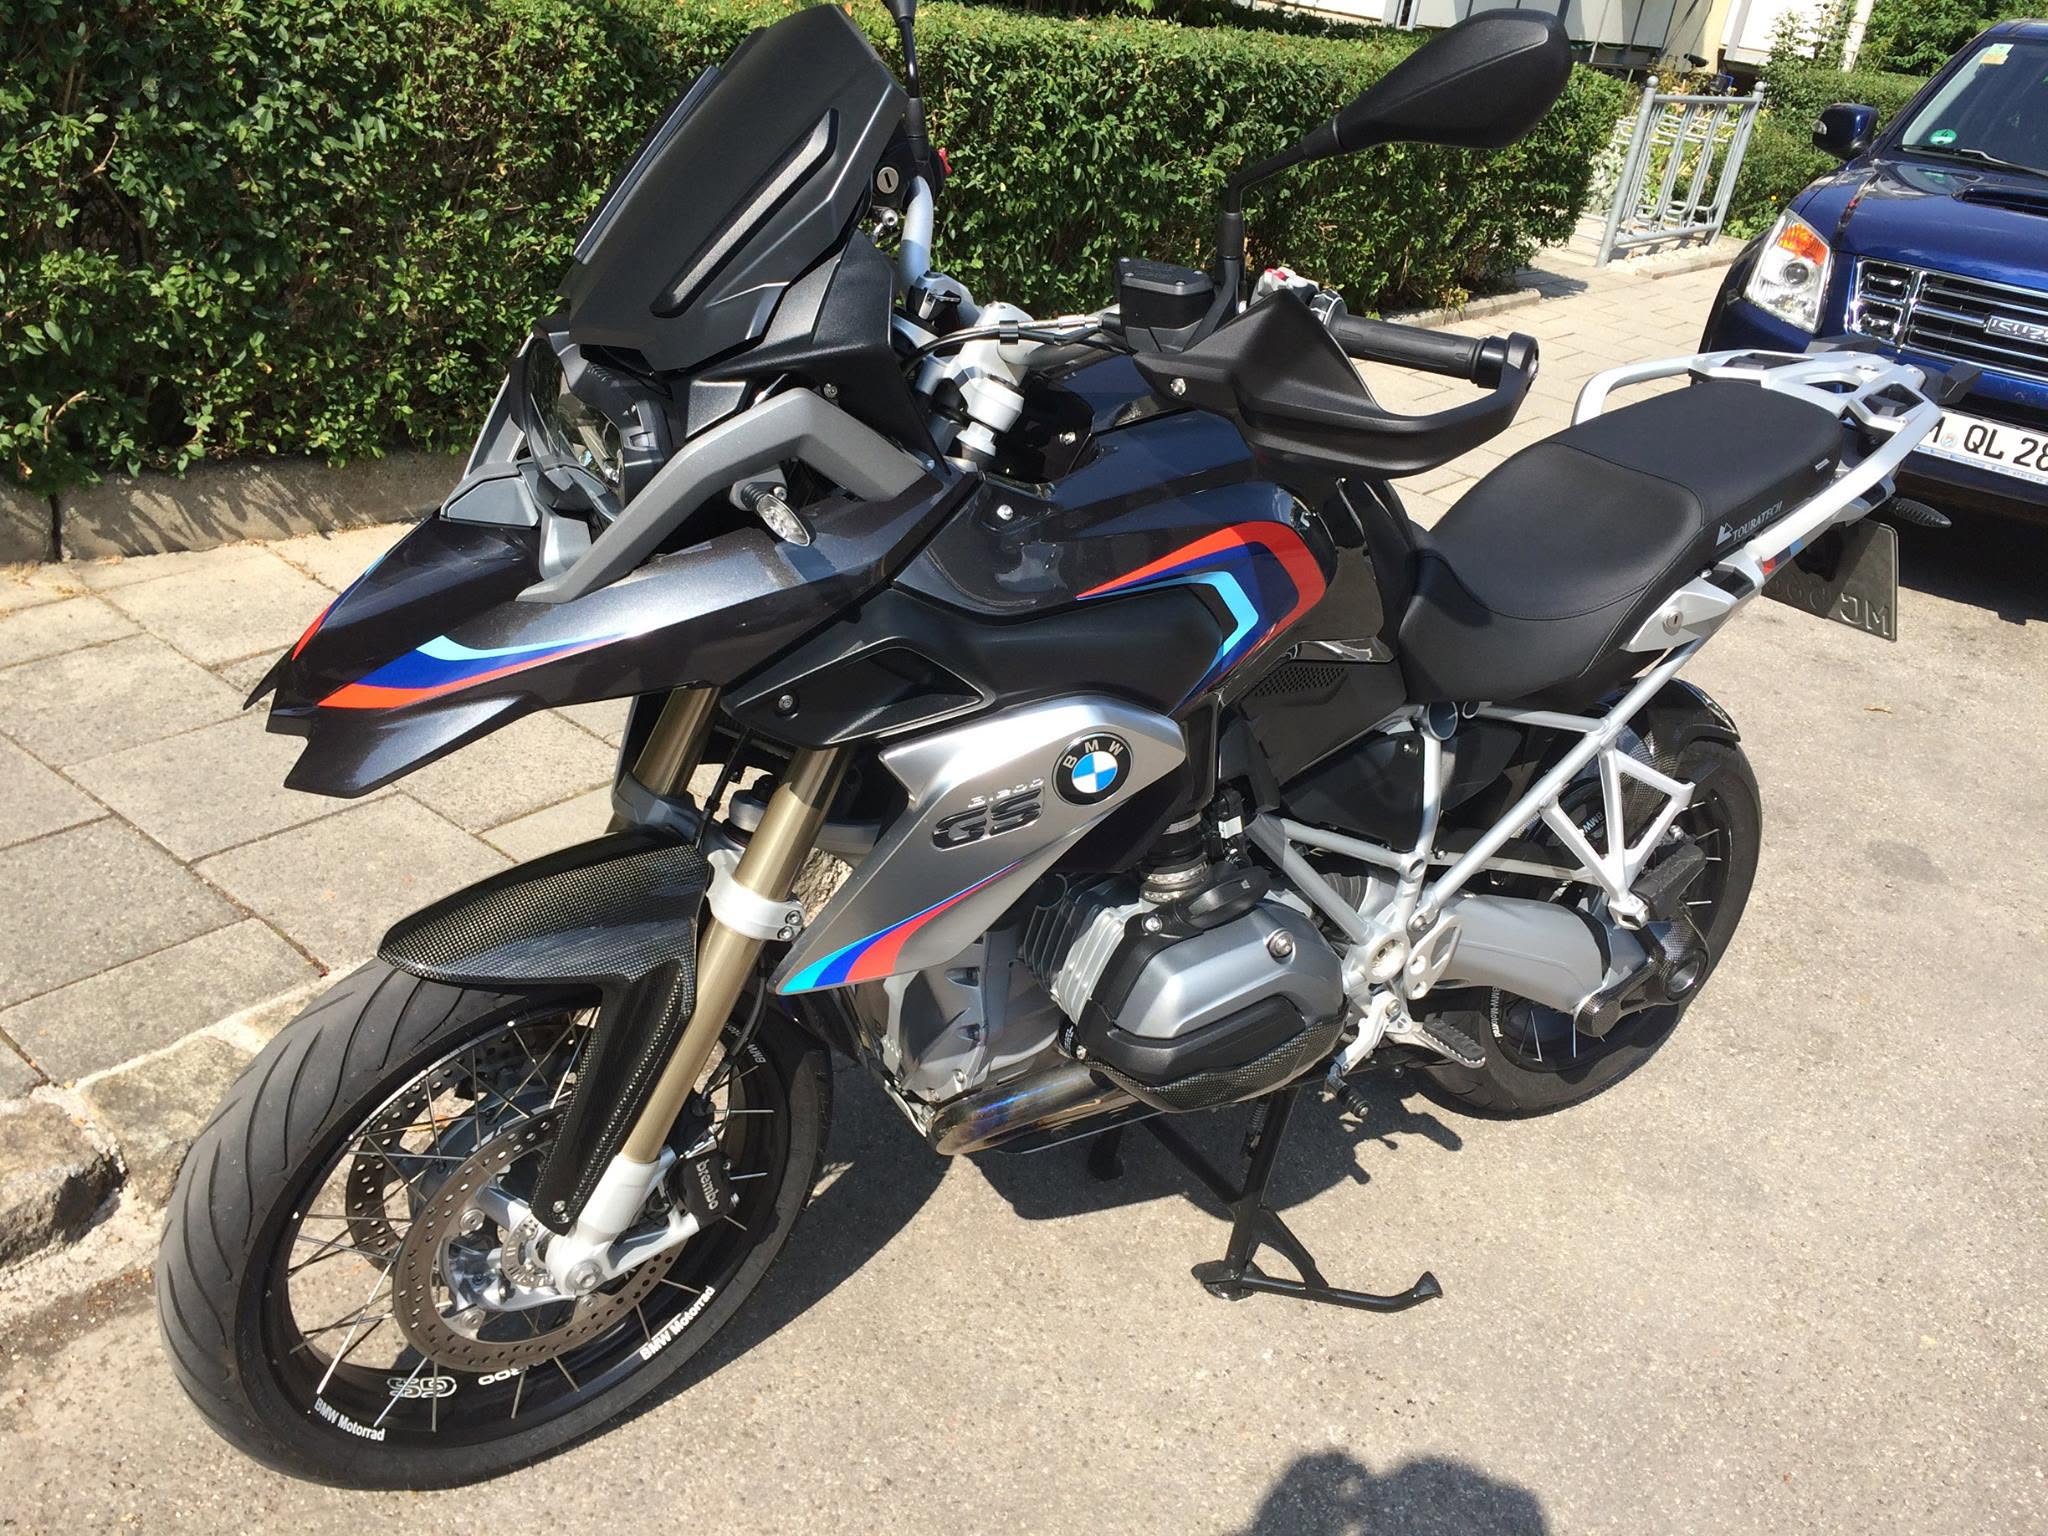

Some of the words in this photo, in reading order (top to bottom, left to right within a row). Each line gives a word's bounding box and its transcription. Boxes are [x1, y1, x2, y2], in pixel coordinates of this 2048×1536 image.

[1963, 424, 2005, 460] QL
[1732, 500, 1783, 541] TOURATECH
[1063, 739, 1124, 770] BMW
[931, 787, 1043, 852] GS
[696, 1158, 720, 1210] brembo
[640, 1329, 672, 1361] BMW
[669, 1284, 716, 1336] Motorrad
[386, 1376, 457, 1398] GS
[314, 1396, 340, 1424] BMW
[337, 1414, 386, 1441] Motorrad
